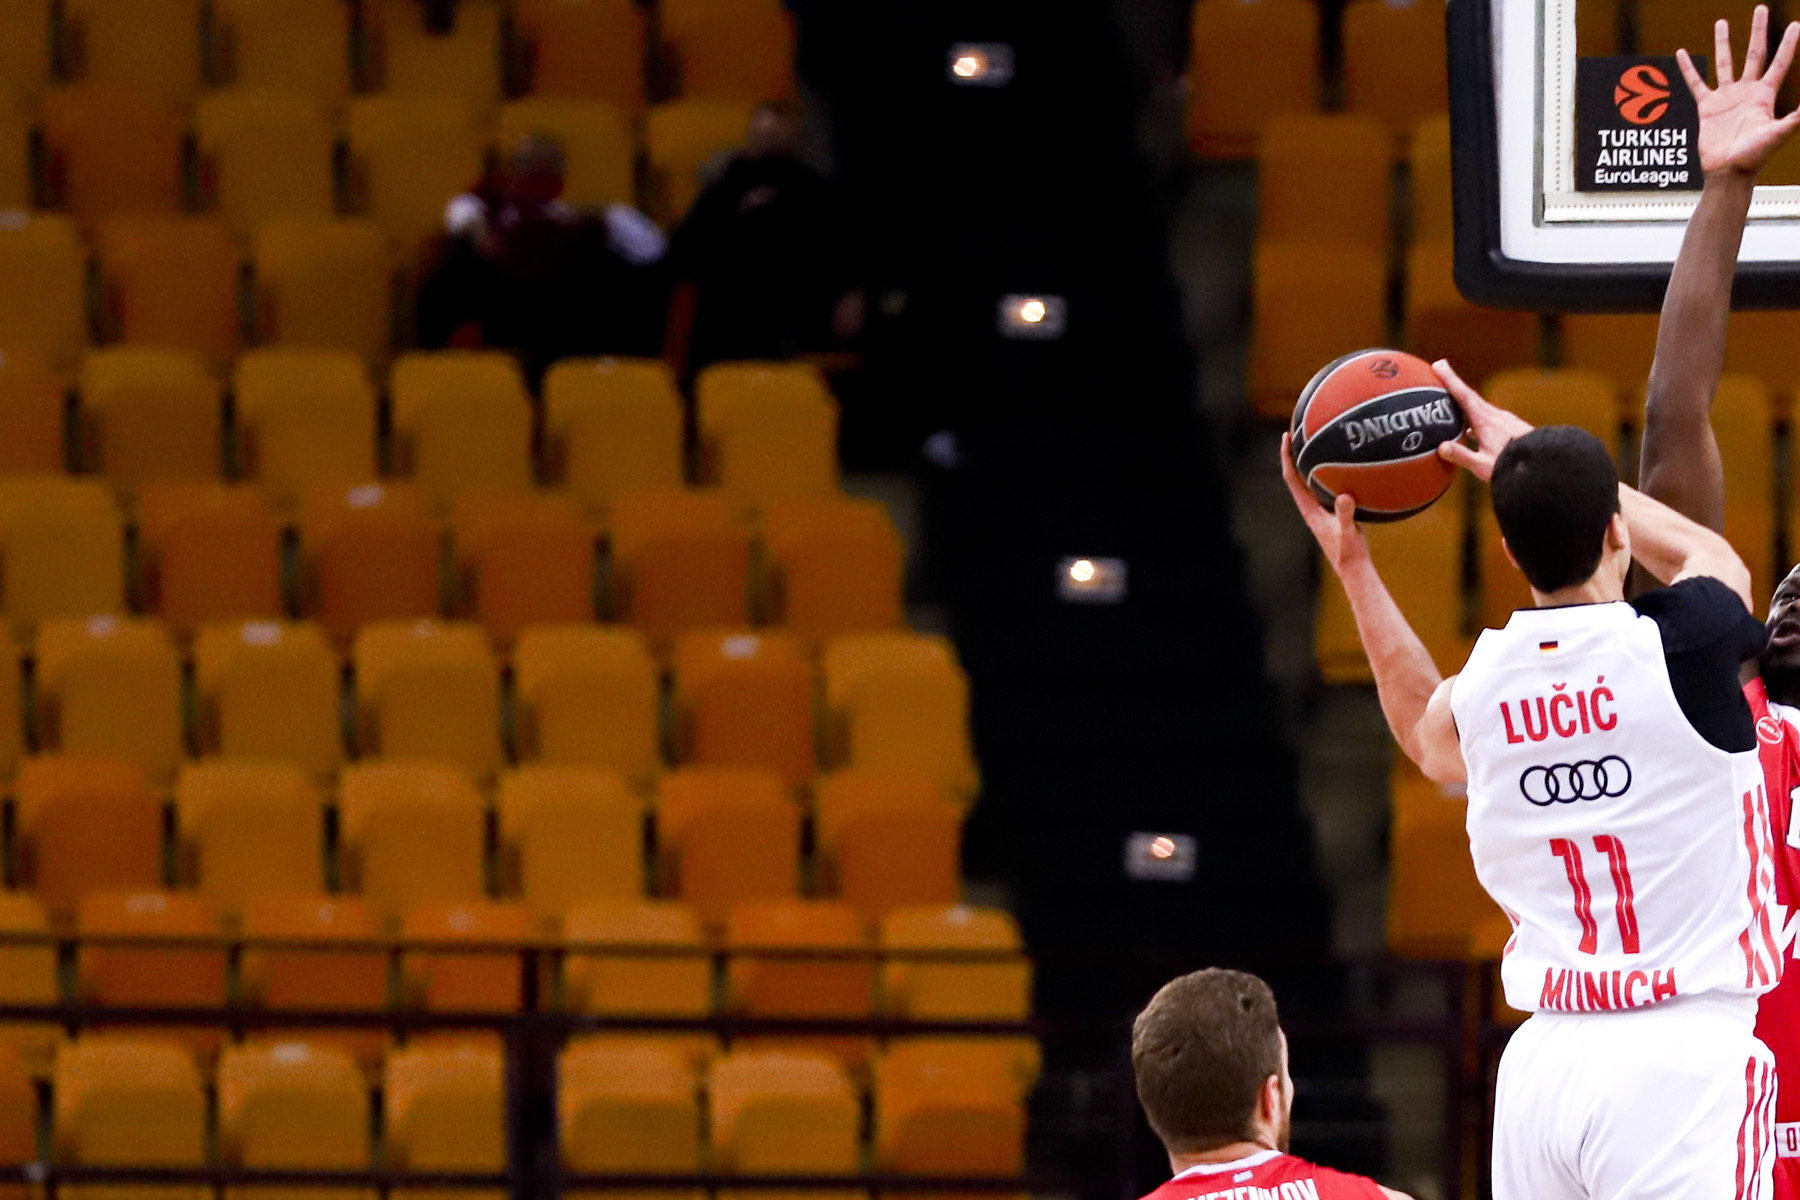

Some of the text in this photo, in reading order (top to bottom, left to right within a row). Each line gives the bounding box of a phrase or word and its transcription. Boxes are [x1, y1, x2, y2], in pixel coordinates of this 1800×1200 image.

[1596, 147, 1688, 167] AIRLINES
[1597, 128, 1688, 147] TURKISH
[1594, 168, 1690, 188] EuroLeague
[1344, 396, 1455, 452] SPALDING
[1499, 674, 1619, 745] LUČIĆ
[1548, 833, 1641, 956] 11
[1538, 966, 1679, 1012] MUNICH
